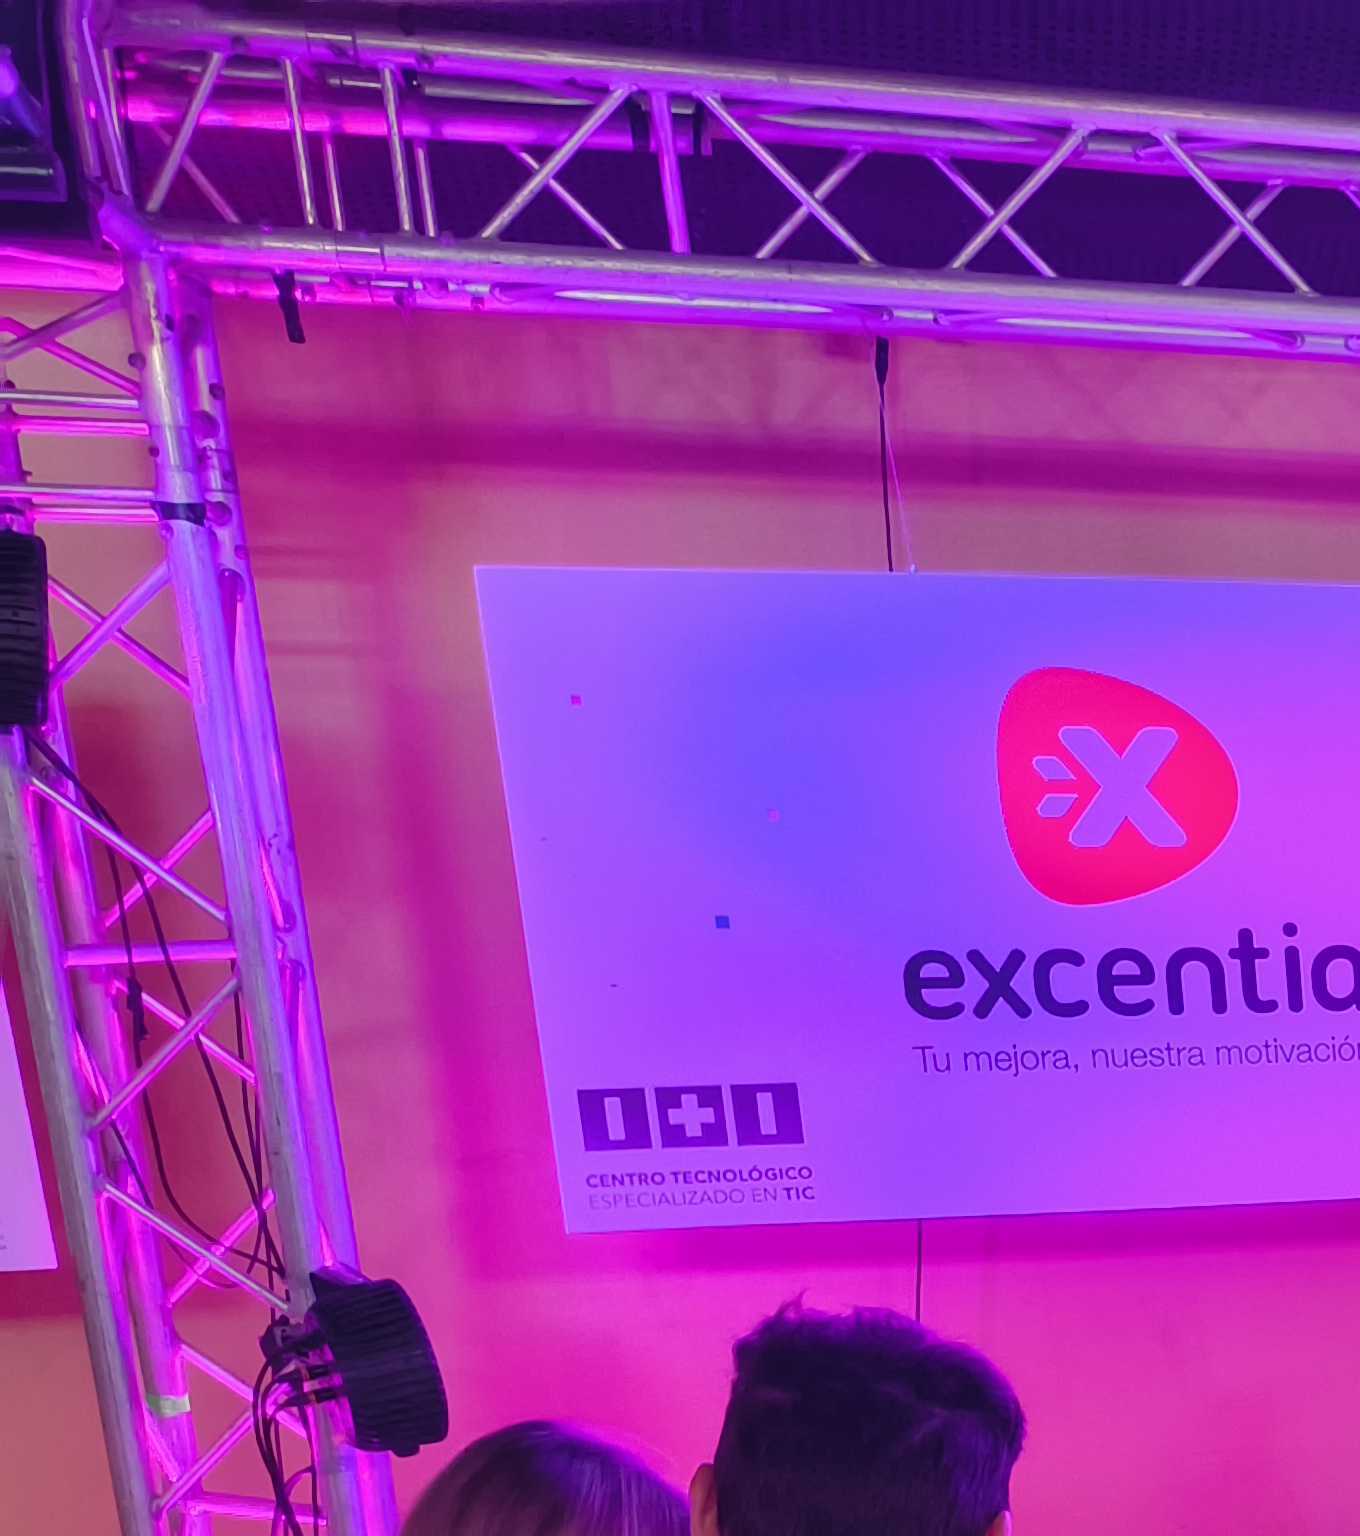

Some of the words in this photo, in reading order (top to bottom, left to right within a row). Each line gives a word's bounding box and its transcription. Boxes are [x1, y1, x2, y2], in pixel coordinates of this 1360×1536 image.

[911, 1046, 951, 1074] Tu
[963, 1043, 1080, 1078] mejora,
[1090, 1041, 1206, 1070] nuestra
[586, 1170, 665, 1188] CENTRO
[667, 1165, 813, 1186] TECNOLÓGICO
[588, 1187, 745, 1210] ESPECIALIZADO
[751, 1186, 778, 1203] EN
[784, 1186, 816, 1202] TIC
